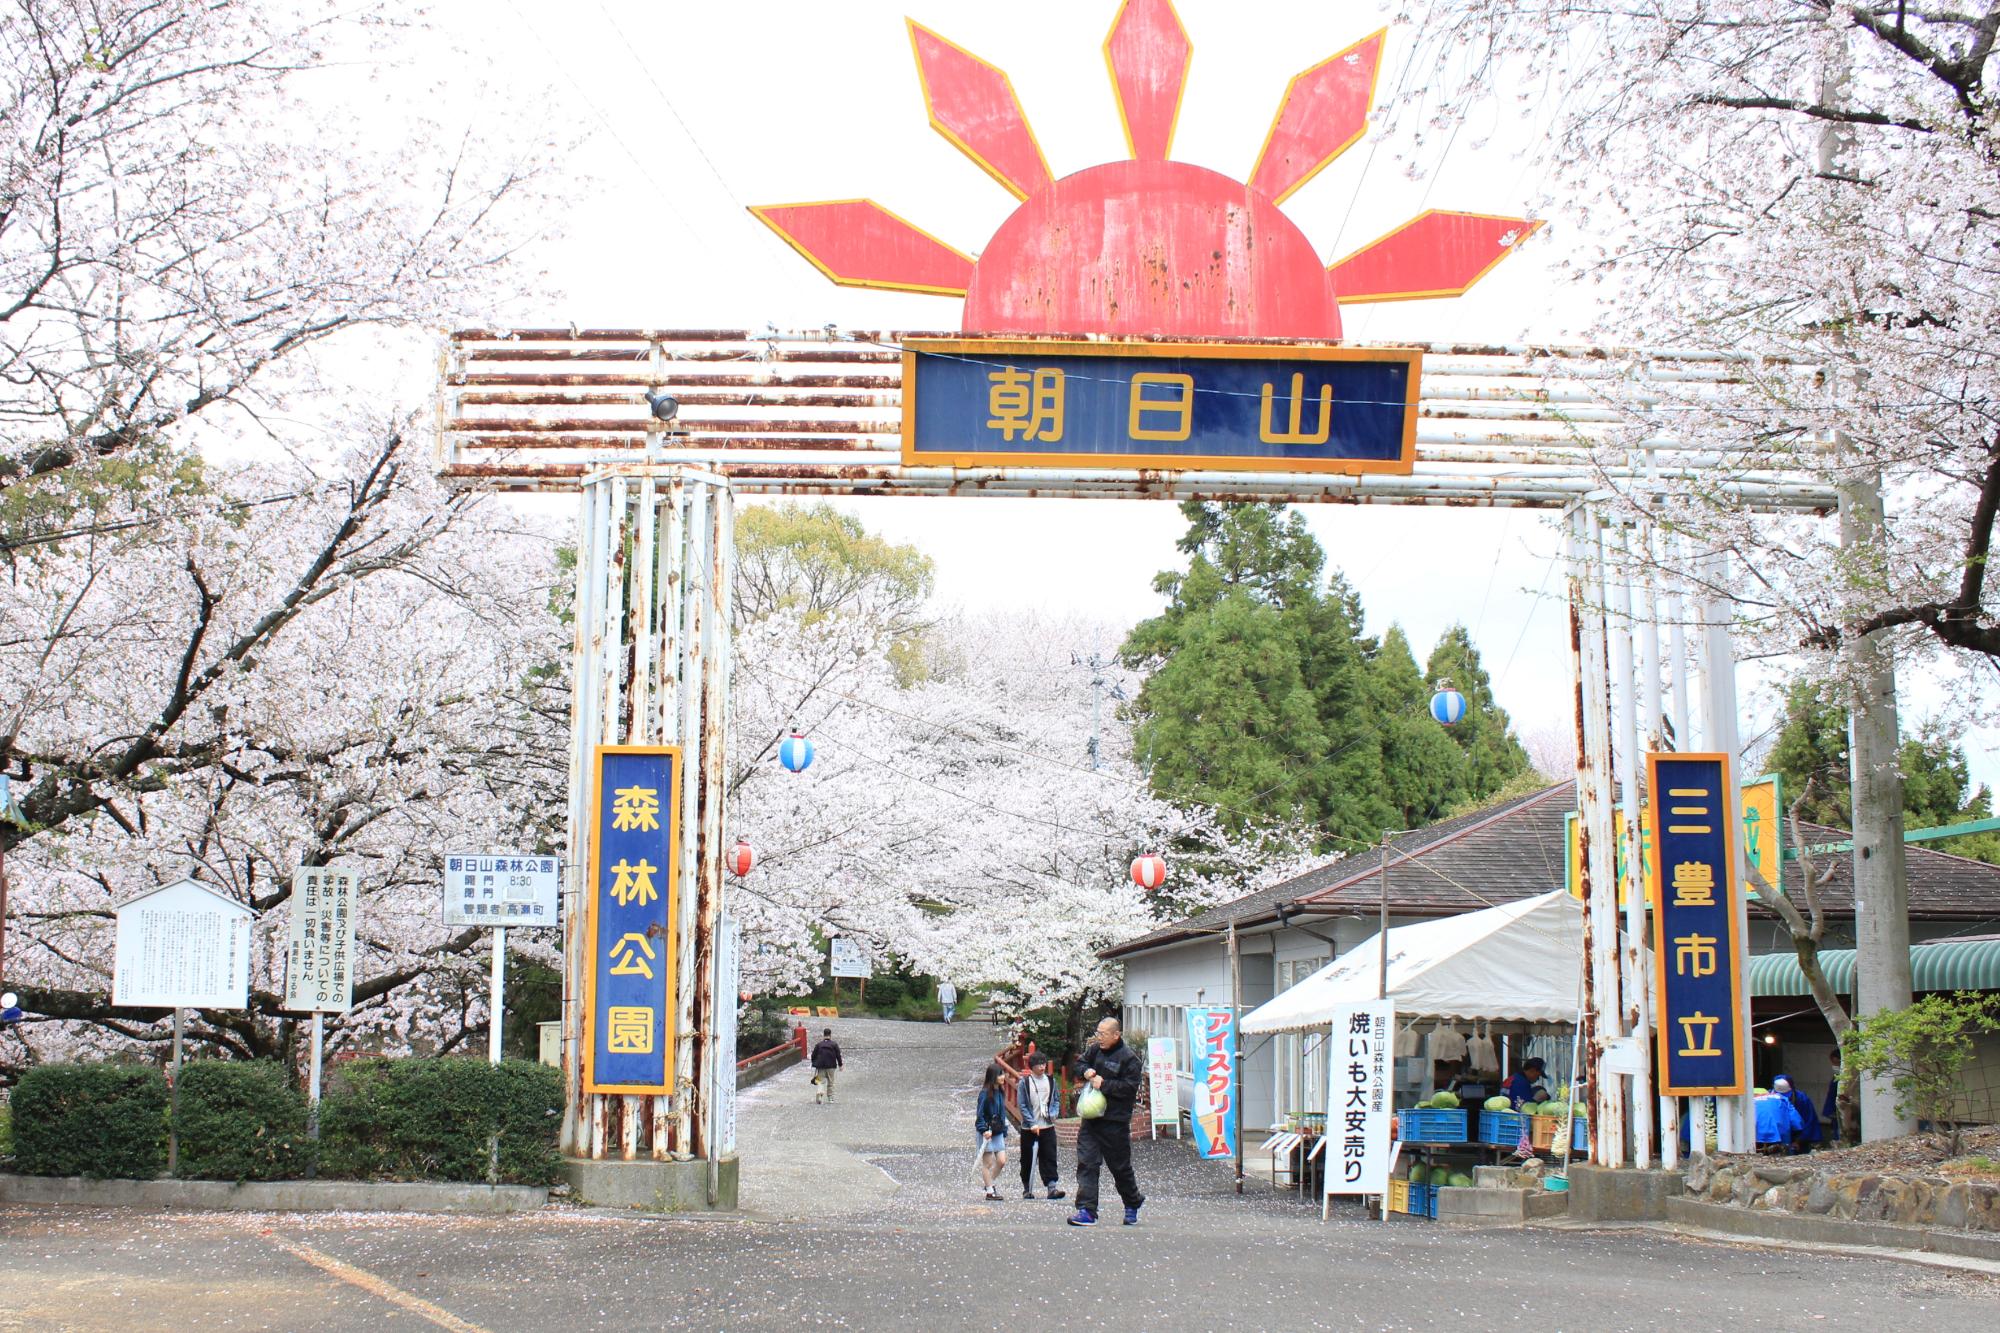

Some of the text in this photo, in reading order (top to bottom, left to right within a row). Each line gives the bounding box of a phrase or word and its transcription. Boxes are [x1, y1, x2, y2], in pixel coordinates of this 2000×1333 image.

[987, 366, 1332, 444] 朝日山
[449, 858, 553, 873] 朝日山森林公園
[510, 876, 532, 886] 8:30
[607, 785, 660, 1054] 森林公園
[1668, 788, 1722, 1057] 三豊市立
[316, 875, 334, 1002] 事故・災害等についての
[332, 876, 349, 1003] 森林公園及び子供広場での
[1206, 1012, 1232, 1156] アイスクリーム
[1344, 1012, 1371, 1182] 焼いも大安売り
[1371, 1016, 1386, 1112] 朝日山森林公園産
